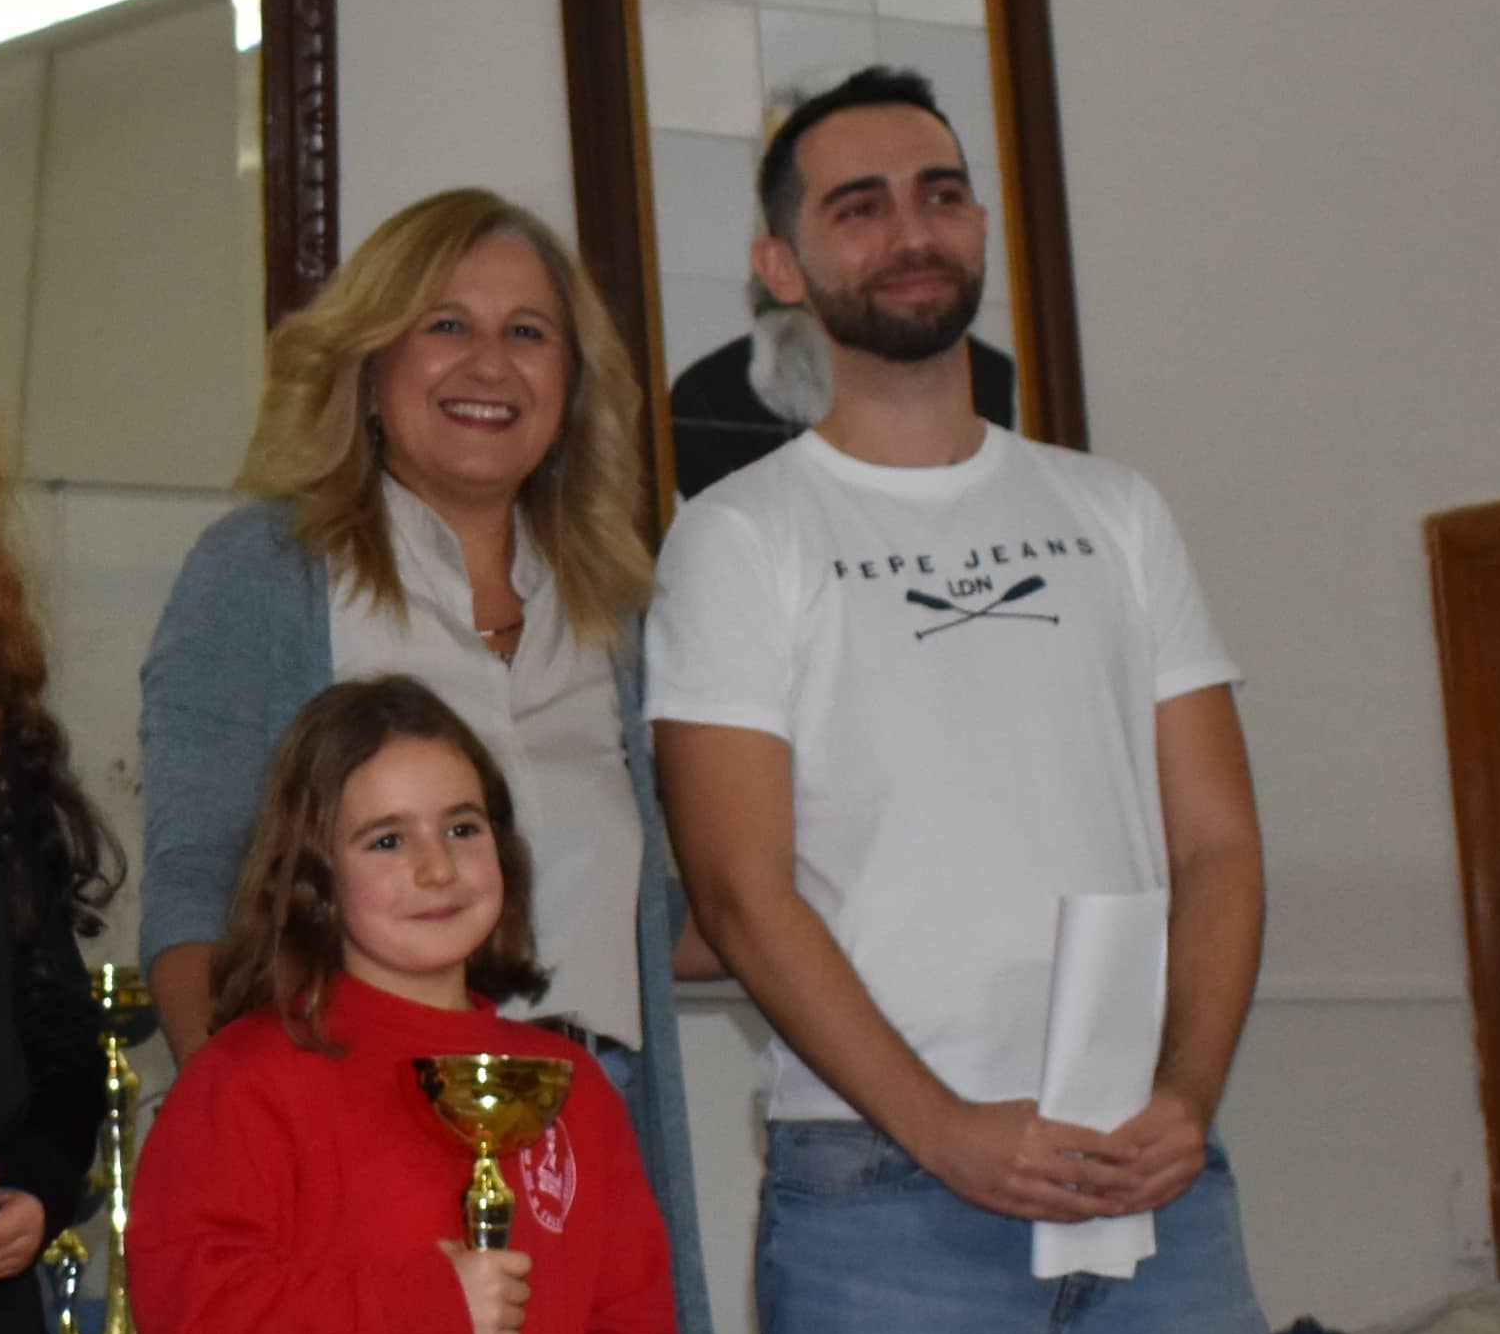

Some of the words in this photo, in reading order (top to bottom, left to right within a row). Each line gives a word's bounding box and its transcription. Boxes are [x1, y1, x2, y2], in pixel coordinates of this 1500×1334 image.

[833, 553, 936, 579] PEPE
[964, 536, 1096, 569] JEANS
[947, 575, 994, 598] LDN
